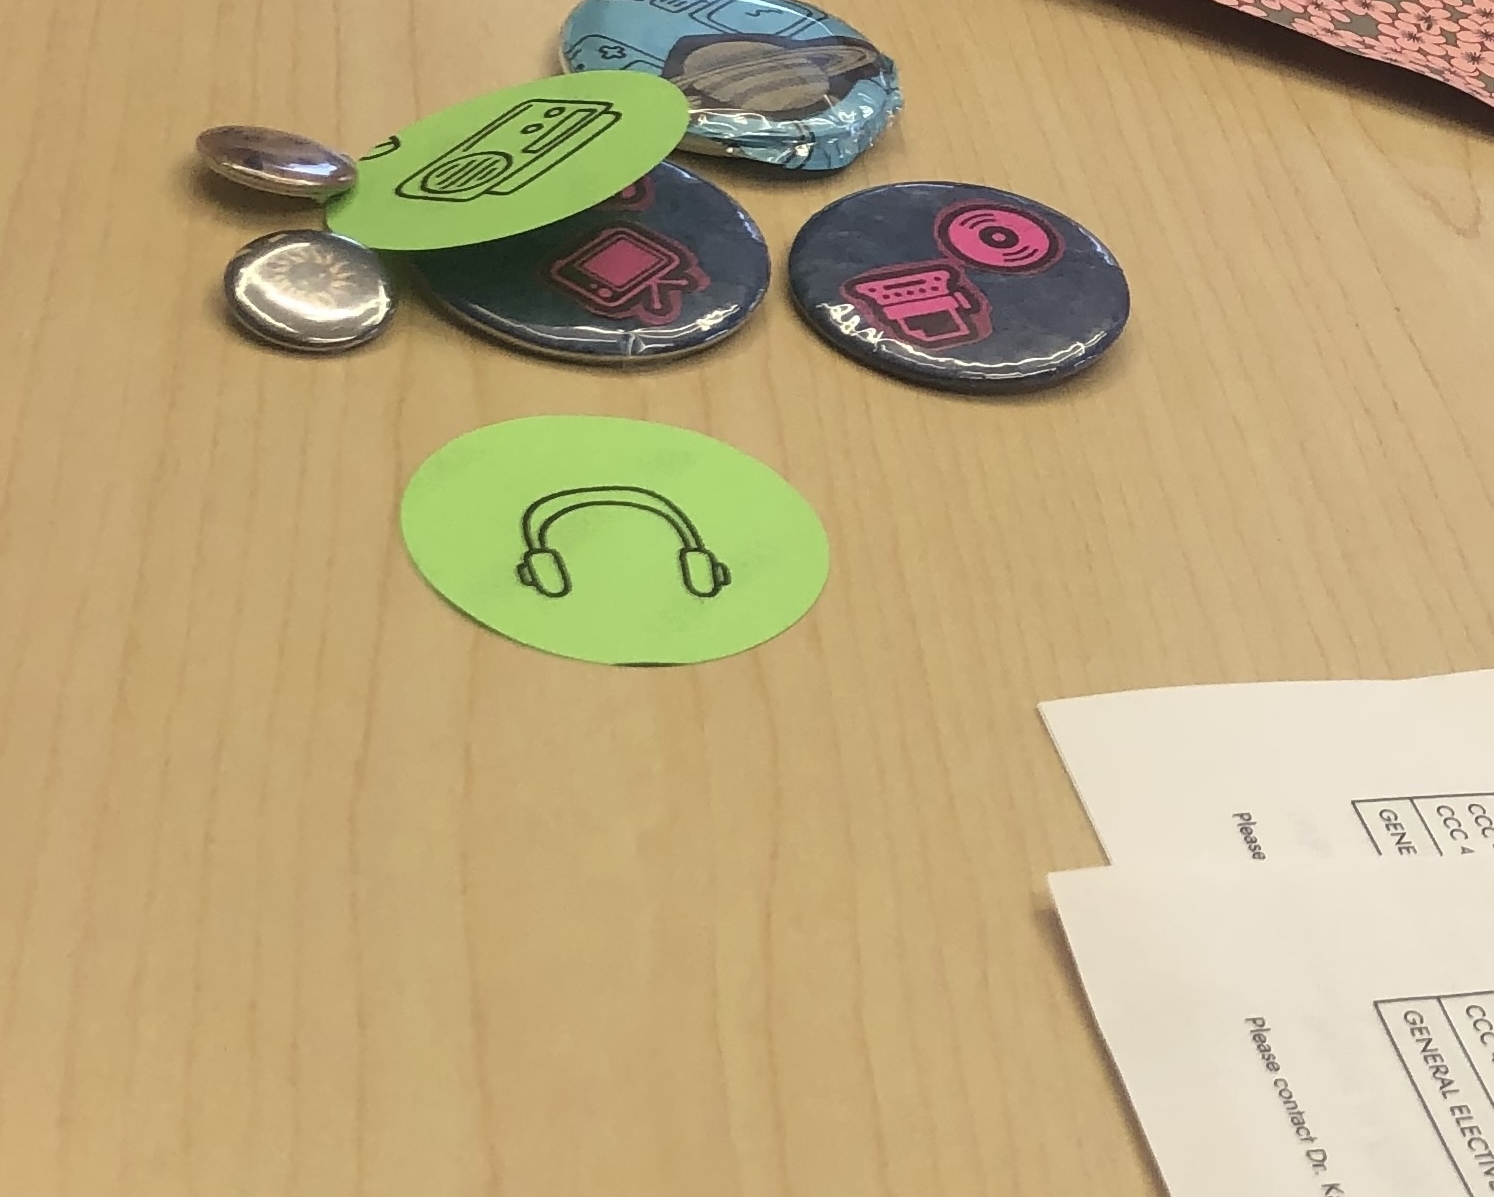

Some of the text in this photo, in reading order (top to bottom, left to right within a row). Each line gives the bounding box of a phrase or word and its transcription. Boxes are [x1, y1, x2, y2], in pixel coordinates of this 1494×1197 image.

[1232, 812, 1266, 860] Please
[1379, 808, 1417, 855] GENE
[1436, 805, 1469, 841] CCC
[1403, 1010, 1460, 1100] GENERAL
[1244, 1017, 1345, 1197] Please contact Dr. K
